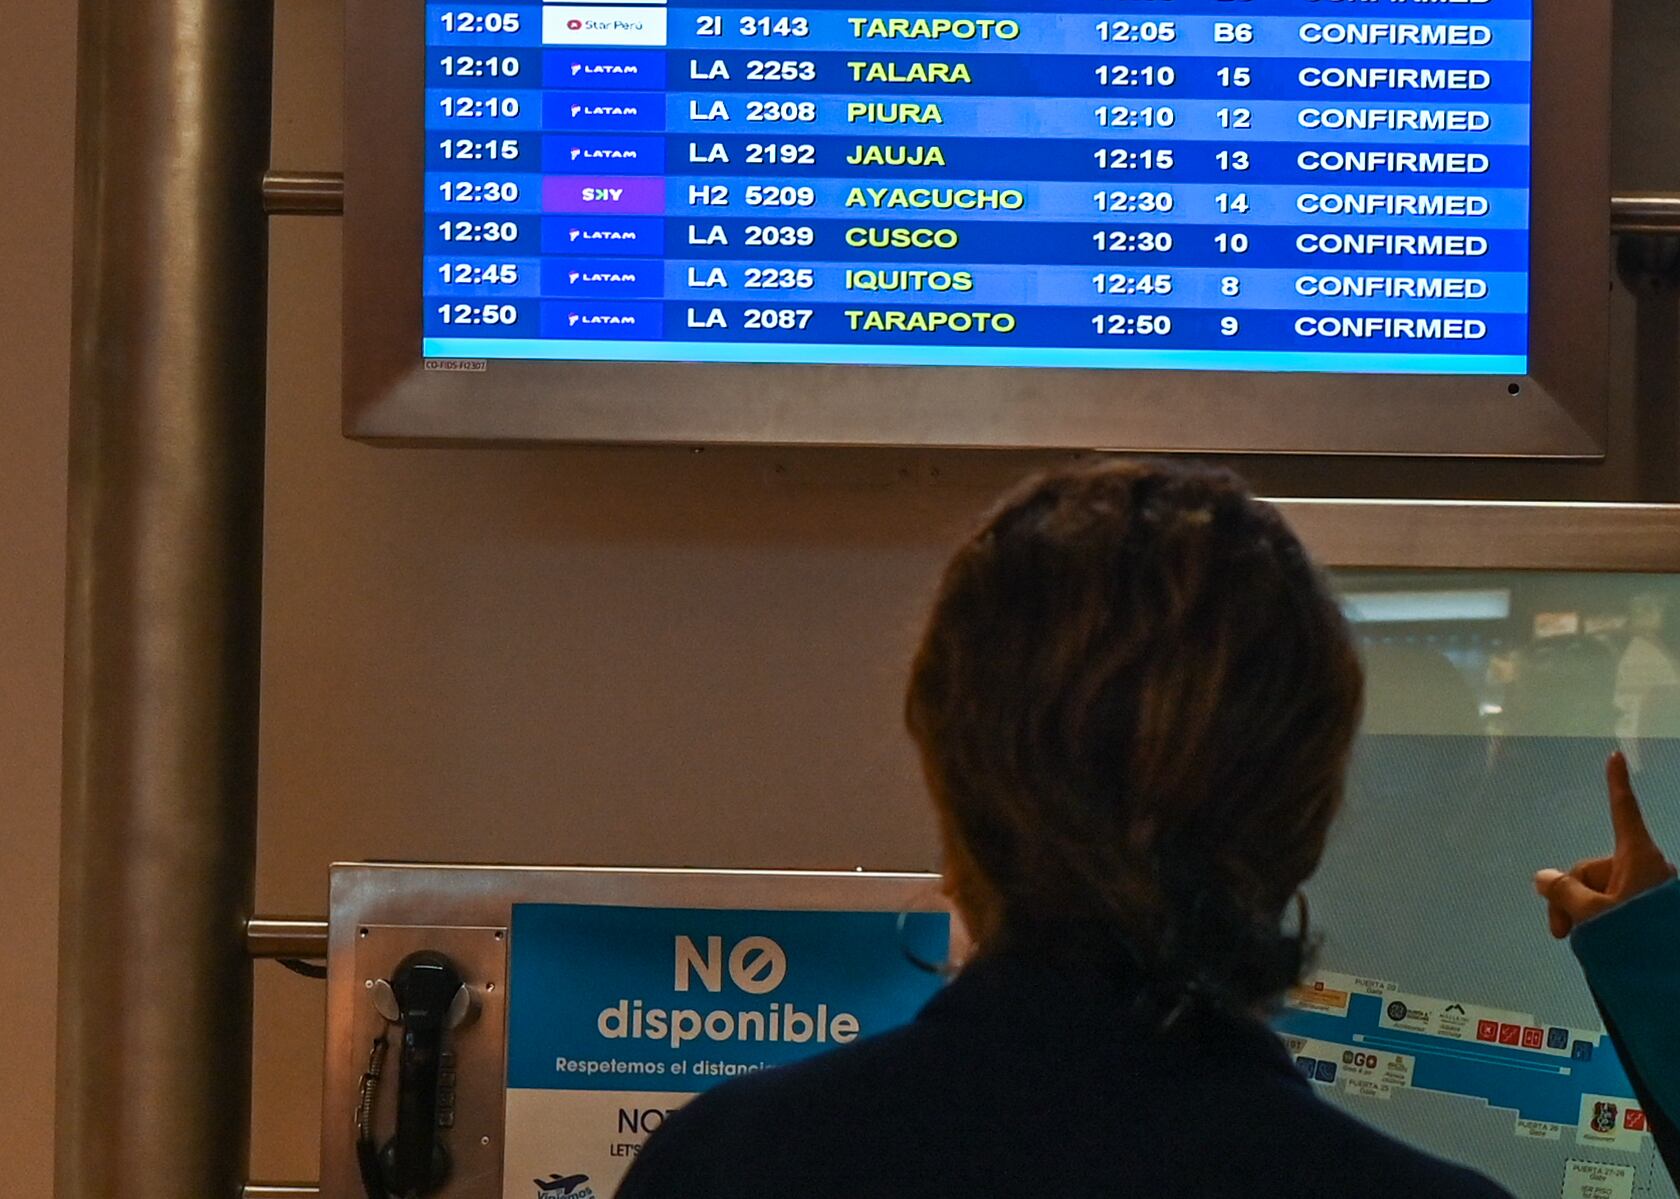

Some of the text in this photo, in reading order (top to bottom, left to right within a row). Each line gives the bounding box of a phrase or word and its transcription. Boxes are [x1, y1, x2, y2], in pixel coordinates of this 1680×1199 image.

[440, 182, 517, 201] 12:30
[689, 185, 727, 204] H2
[746, 186, 814, 205] 5209
[846, 188, 1022, 208] AYACUCHO
[1094, 192, 1172, 211] 12:30
[1216, 194, 1248, 212] 14
[1297, 194, 1487, 215] CONFIRMED
[439, 304, 516, 324] 12:50
[688, 308, 727, 327] LA
[744, 309, 812, 328] 2087
[845, 311, 1014, 332] TARAPOTO
[1092, 315, 1170, 334] 12:50
[1221, 317, 1237, 335] 9
[1295, 317, 1485, 338] CONFIRMED
[673, 934, 787, 995] NO
[598, 1000, 860, 1048] disponible
[556, 1057, 665, 1076] Respetemos
[670, 1060, 687, 1075] el
